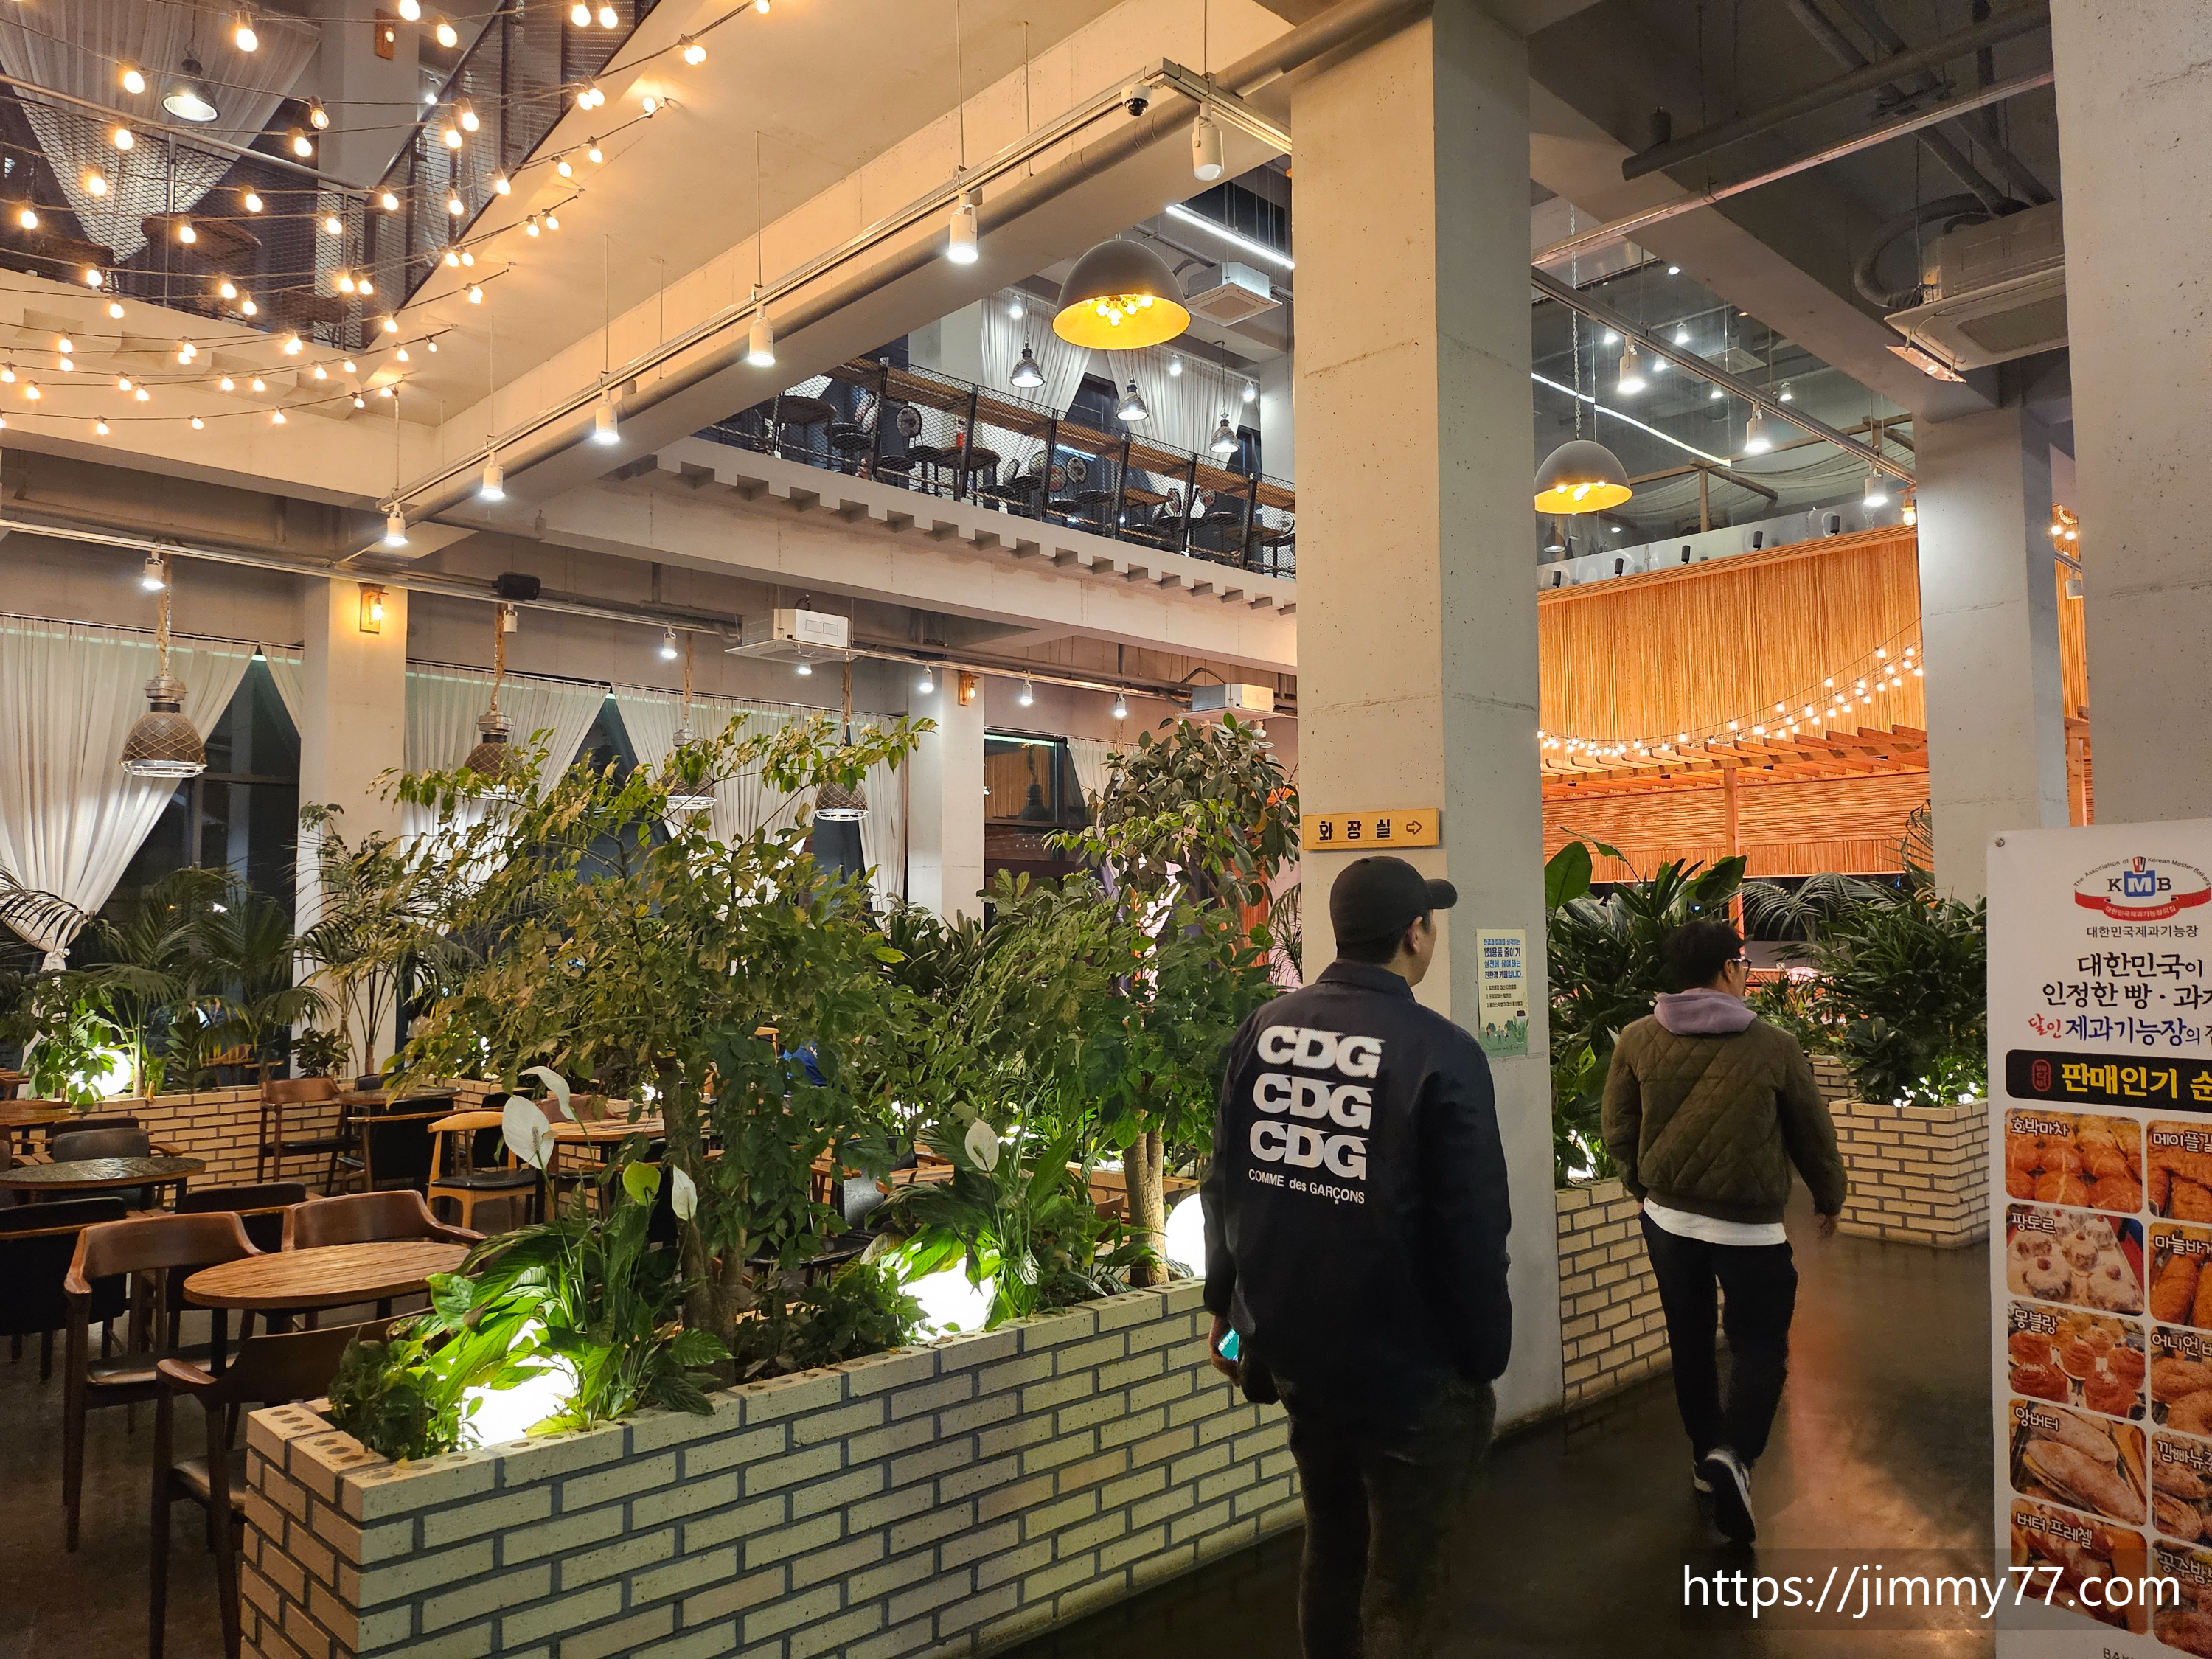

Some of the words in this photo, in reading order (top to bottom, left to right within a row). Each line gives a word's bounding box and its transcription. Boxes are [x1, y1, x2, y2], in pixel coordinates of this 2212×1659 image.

[2073, 877, 2084, 886] The
[2085, 860, 2121, 877] Association
[2171, 859, 2194, 870] Master
[2193, 867, 2211, 886] Bakers
[2107, 877, 2172, 893] KMB
[2086, 925, 2199, 939] 대한민국제과기능장
[2077, 951, 2203, 981] 대한민국이
[2042, 981, 2119, 1009] 인정한
[2124, 982, 2153, 1010] 빵
[2028, 1013, 2062, 1040] 달인
[2065, 1015, 2200, 1047] 제과기능장의
[1257, 1025, 1386, 1079] CDG
[2062, 1062, 2178, 1099] 판매인기
[1253, 1072, 1374, 1130] CDG
[2011, 1117, 2070, 1137] 호박마차
[1249, 1120, 1370, 1180] CDG
[1248, 1169, 1285, 1187] COMME
[1289, 1178, 1307, 1192] des
[1310, 1182, 1366, 1204] GARÇONS
[2011, 1212, 2056, 1234] 팡도르
[2014, 1308, 2059, 1335] 몽블랑
[2152, 1333, 2199, 1357] 어니언
[2015, 1407, 2059, 1430] 앙버터
[2017, 1512, 2047, 1531] 버터
[2049, 1519, 2093, 1549] 프레첼
